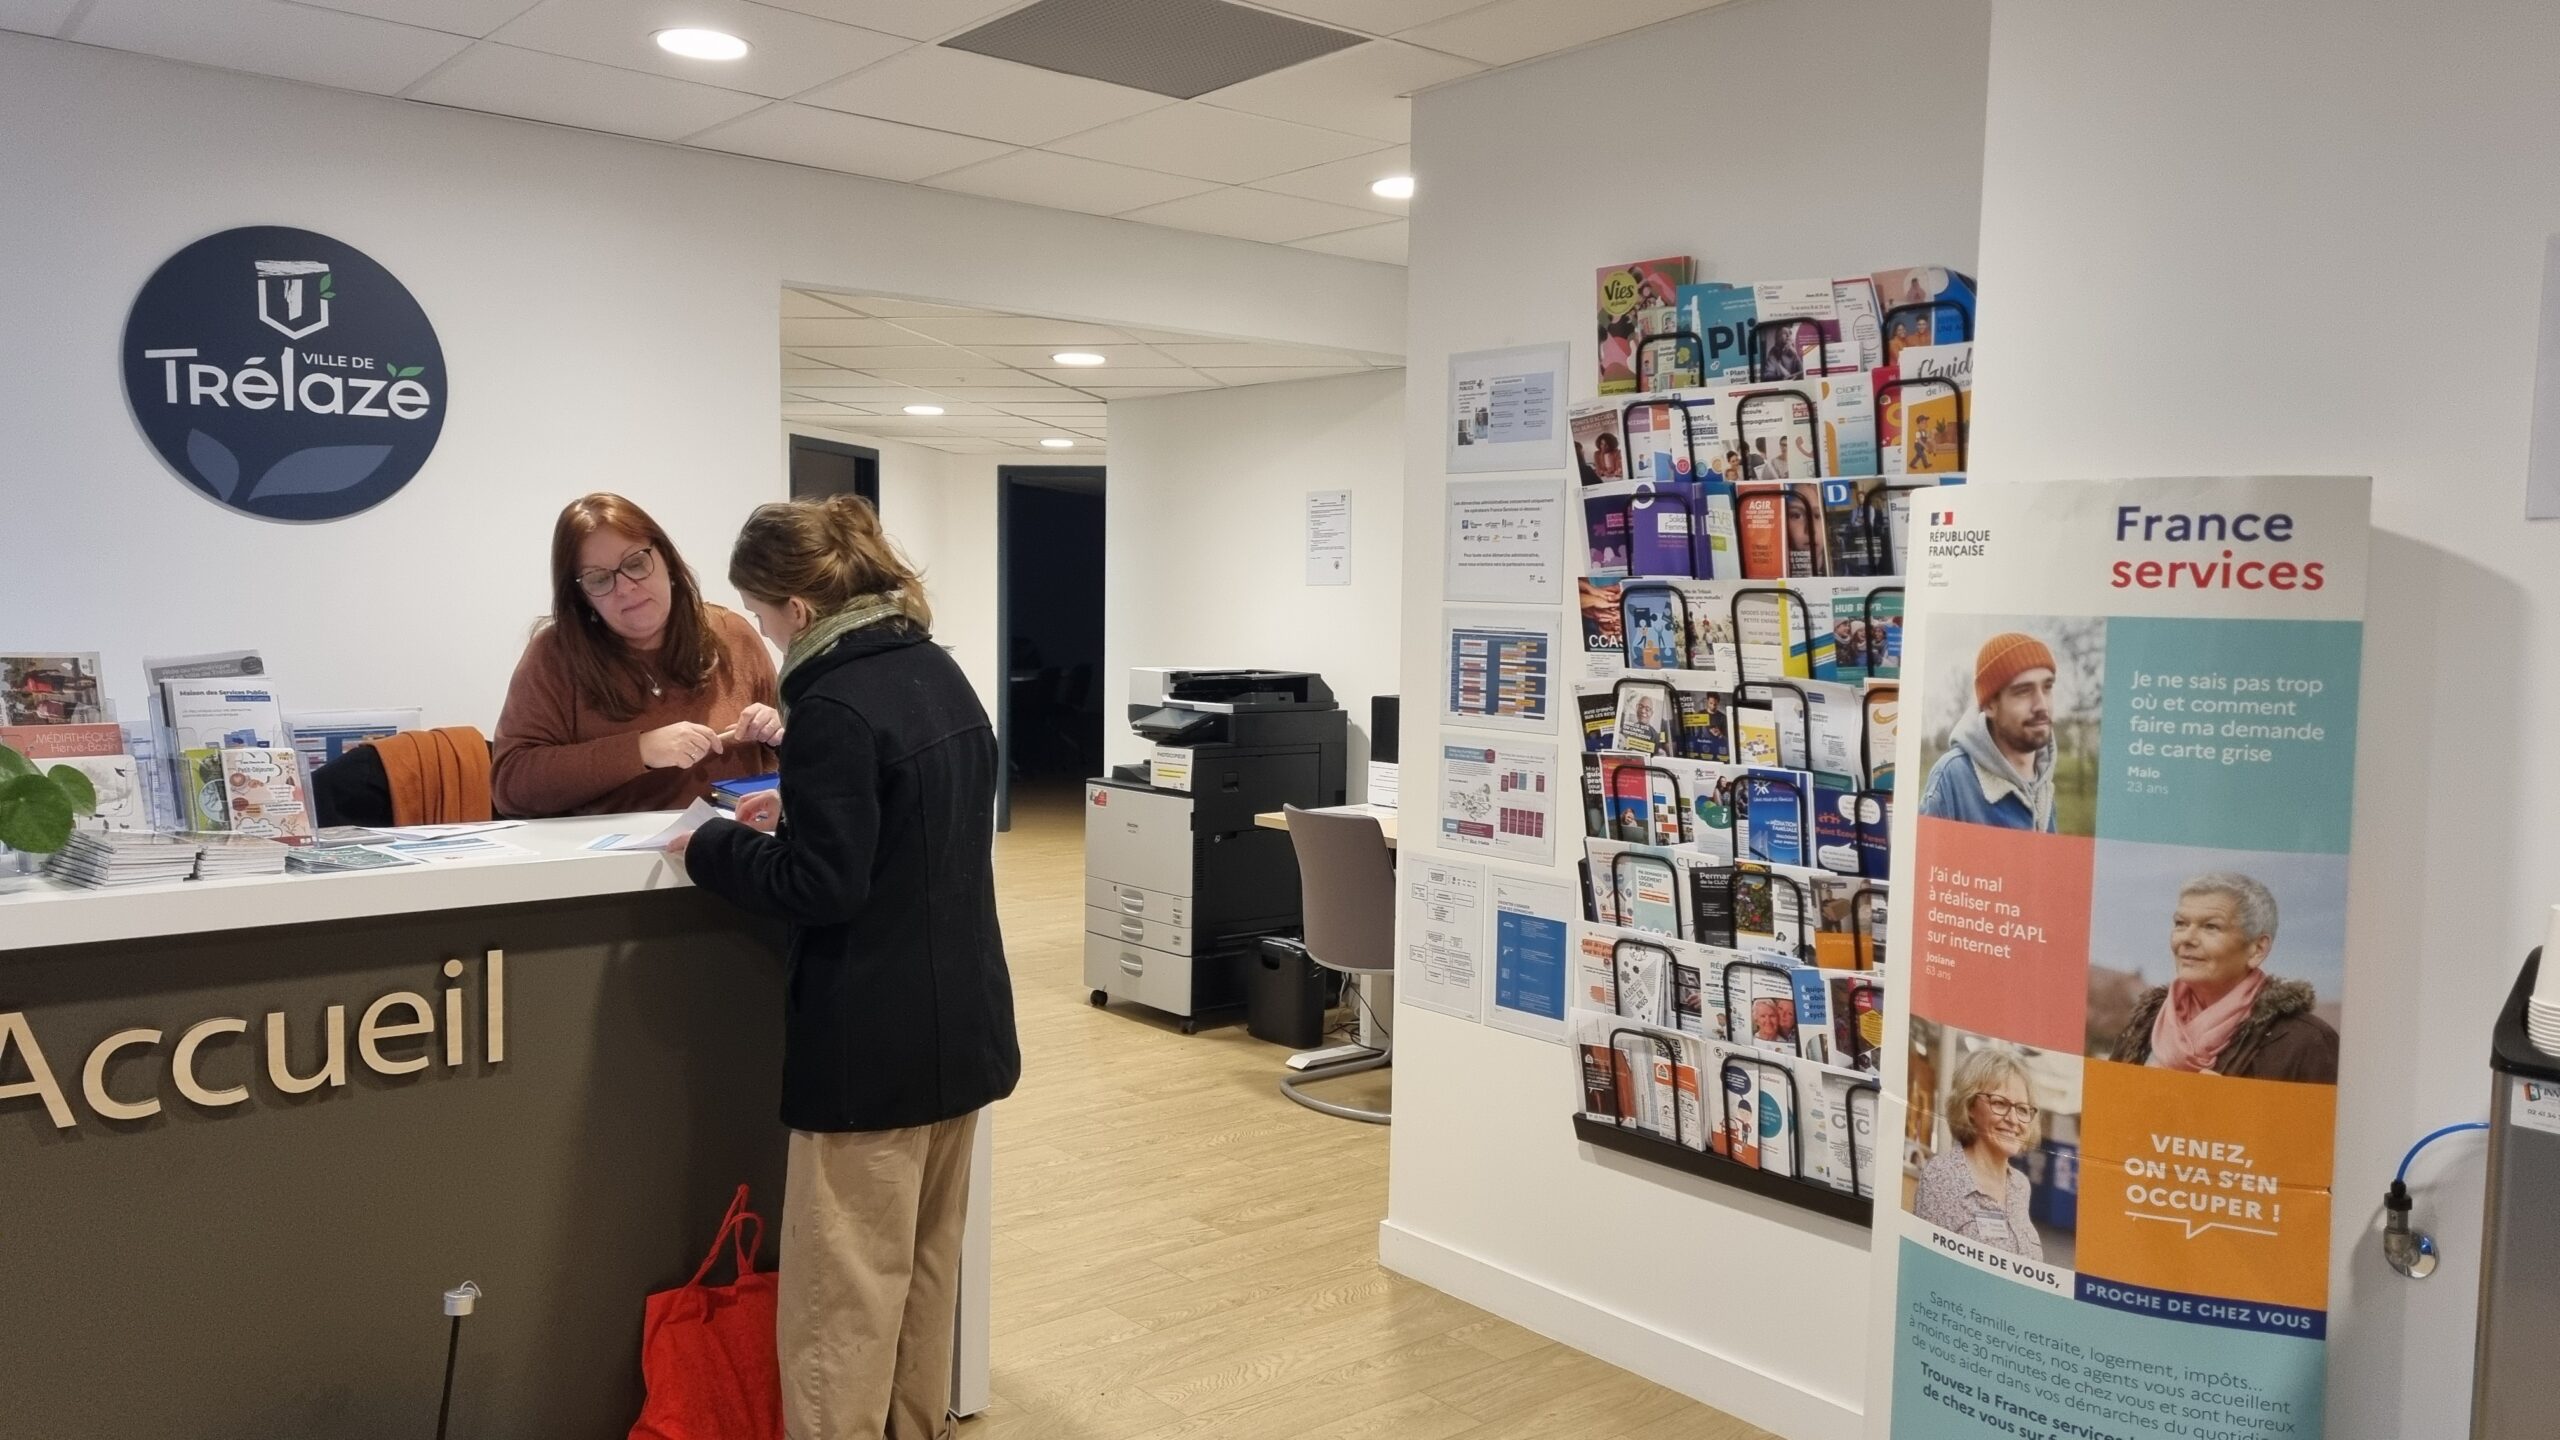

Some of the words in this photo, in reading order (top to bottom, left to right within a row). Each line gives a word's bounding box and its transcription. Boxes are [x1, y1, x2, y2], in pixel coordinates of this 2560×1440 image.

[1604, 279, 1634, 300] Vies
[302, 352, 347, 367] VILLE
[352, 356, 375, 369] DE
[1918, 347, 1973, 386] Guid
[145, 347, 430, 419] Trélazé
[1749, 501, 1771, 510] AGIR
[1929, 530, 1991, 543] RÉPUBLIQUE
[2117, 506, 2293, 542] France
[1928, 545, 1985, 557] FRANÇAISE
[2111, 550, 2324, 590] services
[1834, 604, 1853, 613] HUB
[2131, 670, 2152, 690] Je
[2157, 674, 2183, 689] ne
[2189, 673, 2227, 691] sais
[2233, 677, 2270, 696] pas
[2276, 676, 2323, 698] trop
[2131, 693, 2157, 711] où
[2163, 696, 2185, 712] et
[2190, 699, 2297, 716] comment
[2130, 715, 2176, 734] faire
[2182, 722, 2215, 736] ma
[2220, 721, 2325, 740] demande
[2128, 738, 2155, 756] de
[2160, 742, 2215, 760] carte
[2221, 744, 2272, 765] grise
[2127, 766, 2161, 779] Malo
[2127, 780, 2142, 793] 23
[2146, 783, 2169, 795] ans
[1638, 875, 1663, 883] LOGEMENT
[1928, 866, 1948, 883] J'ai
[1951, 870, 1970, 887] du
[1974, 877, 2003, 893] mal
[1929, 886, 1936, 901] à
[1940, 889, 1991, 912] réaliser
[1995, 902, 2020, 918] ma
[1928, 907, 1994, 934] demande
[1999, 921, 2047, 944] d'APL
[1926, 952, 1956, 968] Josiane
[1927, 930, 1947, 944] sur
[1950, 932, 2011, 959] internet
[1937, 969, 1951, 981] ans
[0, 950, 504, 1129] Accueil
[2151, 1133, 2253, 1169] VENEZ,
[2124, 1157, 2166, 1180] ON
[2174, 1164, 2211, 1186] VA
[2218, 1170, 2278, 1195] S'EN
[2126, 1184, 2263, 1220] OCCUPER
[2272, 1204, 2280, 1223] !
[1932, 1232, 1985, 1263] PROCHE
[1989, 1254, 2008, 1271] DE
[2012, 1261, 2060, 1289] VOUS,
[2086, 1282, 2161, 1310] PROCHE
[2167, 1298, 2192, 1314] DE
[2198, 1303, 2251, 1322] CHEZ
[2256, 1310, 2311, 1330] VOUS
[1930, 1291, 1967, 1319] Santé,
[1969, 1308, 2020, 1338] famille,
[2024, 1329, 2085, 1360] retraite,
[2090, 1347, 2178, 1381] logement,
[1908, 1314, 1916, 1327] à
[1917, 1321, 1951, 1345] moins
[1953, 1337, 1969, 1352] de
[1972, 1345, 1988, 1360] 30
[1991, 1353, 2047, 1382] minutes
[2051, 1373, 2071, 1389] de
[2074, 1381, 2112, 1400] chez
[2116, 1393, 2155, 1411] vous
[2159, 1401, 2177, 1416] et
[2182, 1406, 2219, 1423] sont
[2226, 1410, 2296, 1434] heureux
[1912, 1301, 1938, 1322] chez
[1941, 1313, 1982, 1341] France
[1985, 1333, 2046, 1365] services,
[2051, 1356, 2078, 1375] nos
[2083, 1366, 2139, 1389] agents
[2144, 1380, 2185, 1399] vous
[2190, 1390, 2291, 1415] accueillent
[1912, 1334, 1926, 1350] de
[1928, 1343, 1956, 1364] vous
[1959, 1356, 1993, 1379] aider
[1996, 1372, 2031, 1394] dans
[2034, 1386, 2060, 1404] vos
[2064, 1394, 2159, 1430] démarches
[2164, 1418, 2187, 1435] du
[2193, 1424, 2272, 1440] quotidi
[1921, 1361, 1973, 1397] Trouvez
[1977, 1386, 1990, 1404] la
[1994, 1395, 2047, 1425] France
[1923, 1384, 1939, 1401] de
[1942, 1394, 1975, 1418] chez
[1979, 1409, 2015, 1434] vous
[2019, 1425, 2045, 1440] sur
